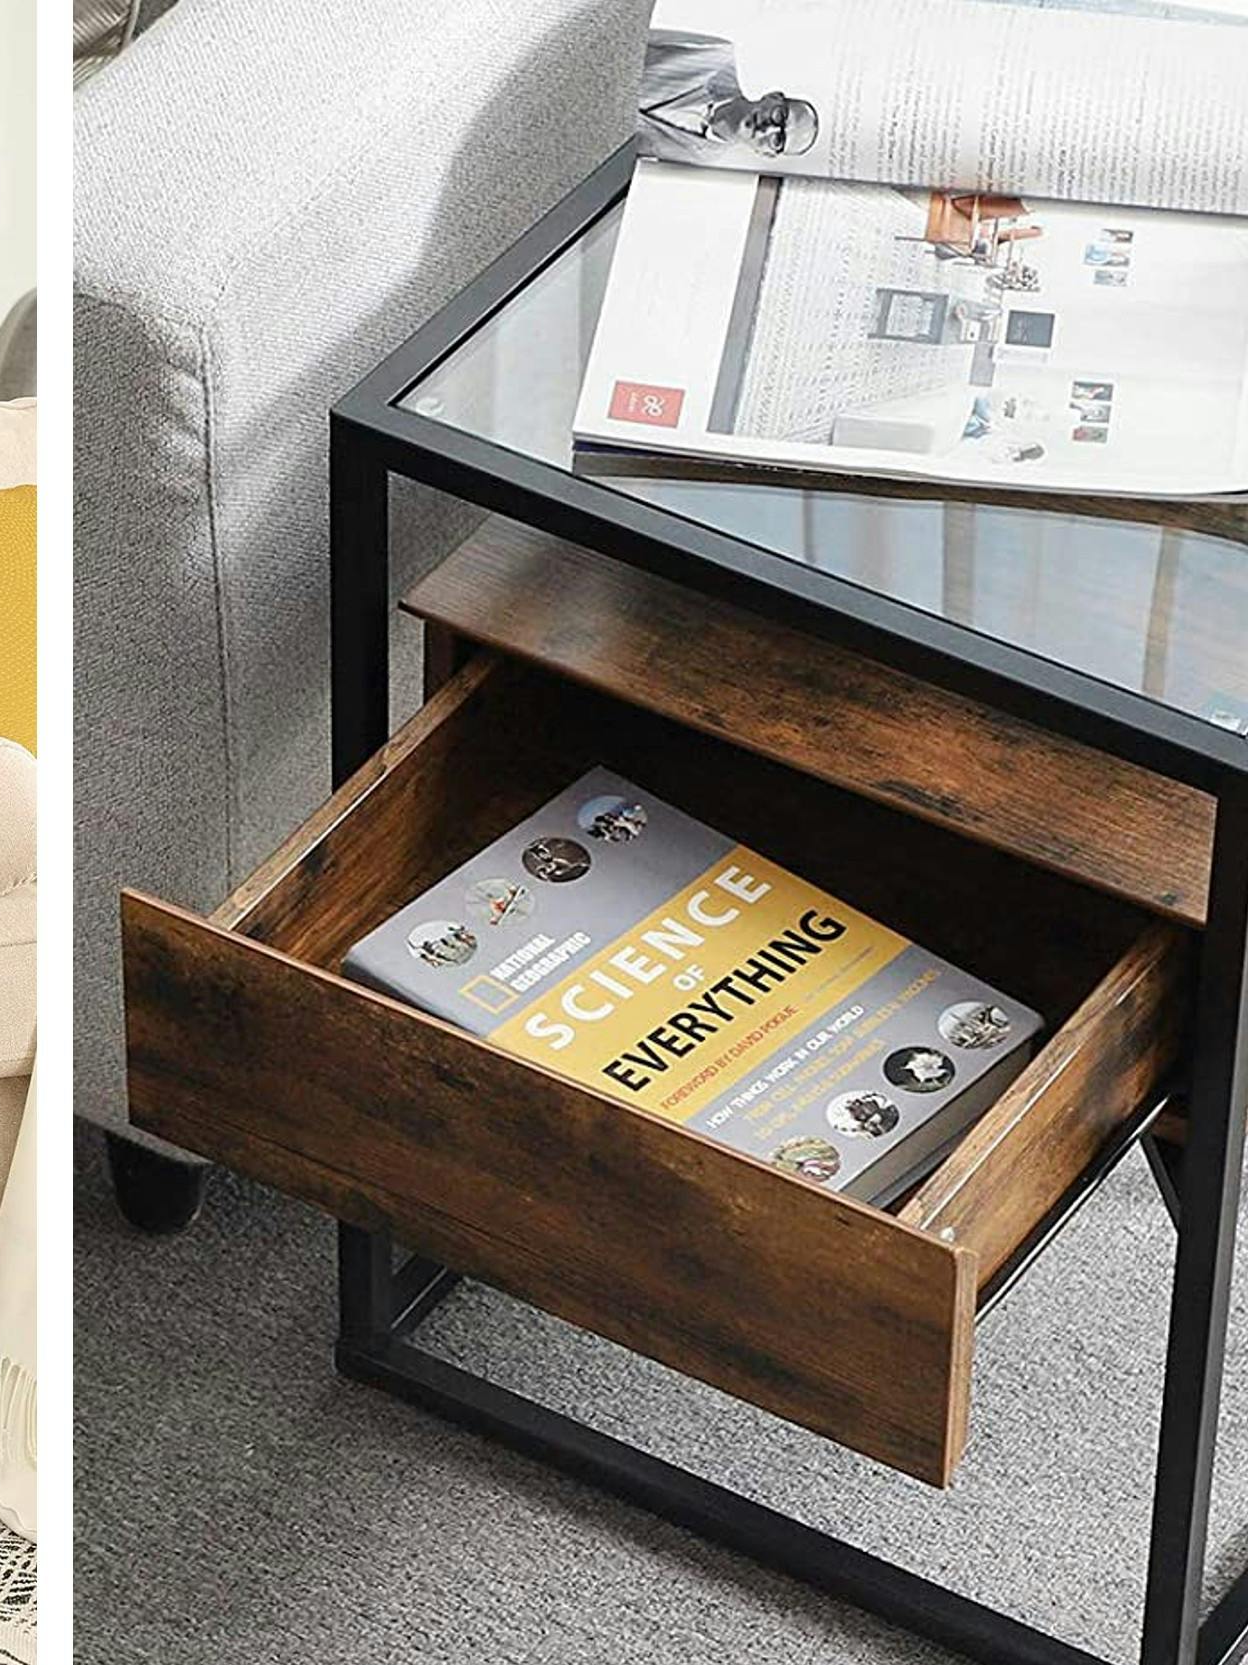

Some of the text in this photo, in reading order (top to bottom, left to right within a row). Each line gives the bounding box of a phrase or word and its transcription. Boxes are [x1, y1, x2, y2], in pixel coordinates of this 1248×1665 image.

[490, 933, 555, 981] NATIONAL
[510, 931, 591, 993] GEOGRAPHIC
[525, 866, 772, 1050] SCIENCE
[672, 964, 706, 991] OF
[602, 910, 847, 1092] EVERYTHING
[660, 1065, 719, 1110] FOREWORD
[715, 1054, 734, 1069] BY
[727, 1030, 764, 1058] DAVID
[706, 1105, 734, 1130] HOW
[729, 1079, 769, 1108] THINGS
[764, 1057, 799, 1083] WORK
[794, 1048, 810, 1061] IN
[805, 1030, 834, 1051] OUR
[826, 1004, 865, 1034] WORLD
